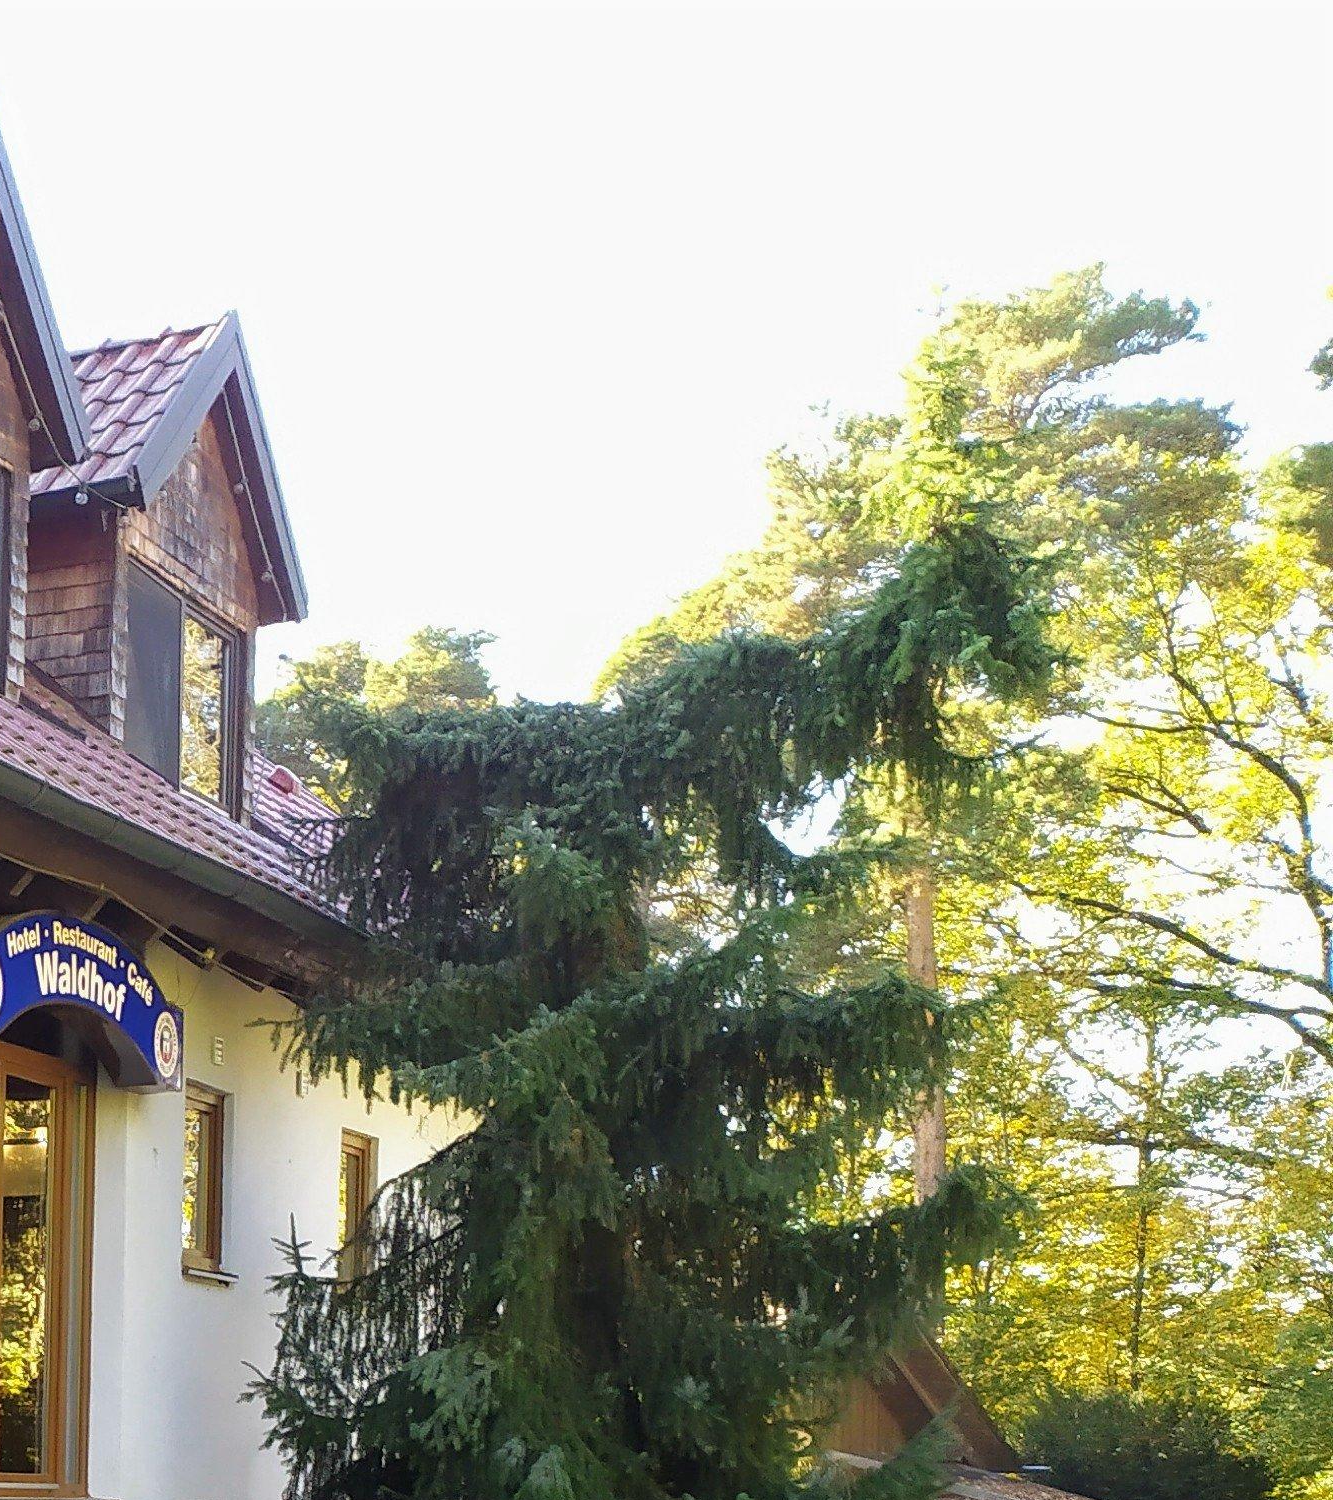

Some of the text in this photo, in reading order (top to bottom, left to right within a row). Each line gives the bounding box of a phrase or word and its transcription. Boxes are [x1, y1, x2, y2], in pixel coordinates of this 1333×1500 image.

[6, 920, 154, 1007] Hotel Restaurant Café
[34, 950, 127, 1022] Waldhof
